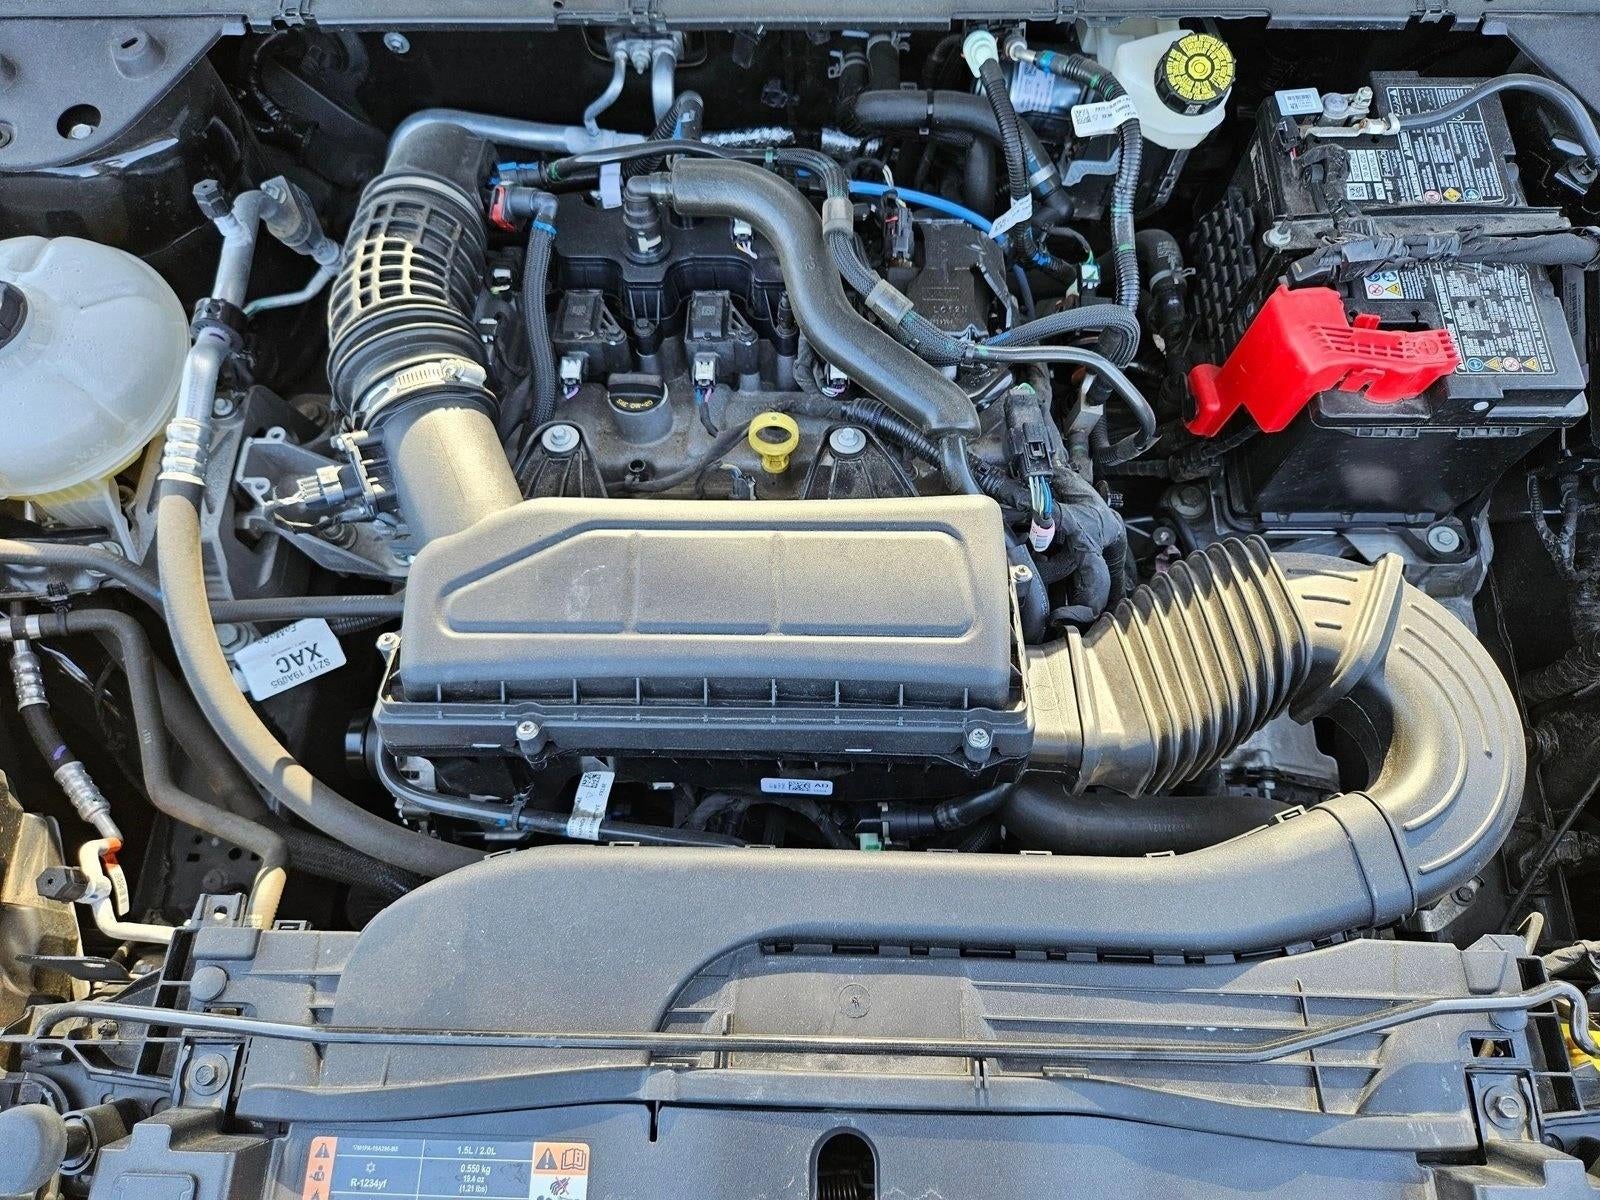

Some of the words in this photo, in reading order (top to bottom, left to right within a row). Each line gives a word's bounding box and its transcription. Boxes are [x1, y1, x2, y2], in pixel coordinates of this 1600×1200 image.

[276, 642, 324, 674] XAC
[457, 1146, 474, 1154] 1.5L
[480, 1146, 497, 1156] 2.0L
[460, 1164, 479, 1173] 0.550
[480, 1164, 491, 1176] kg
[350, 1178, 387, 1190] R-1234yf
[463, 1175, 476, 1183] 19.4
[459, 1185, 475, 1193] (1.21
[475, 1185, 488, 1193] lbs)
